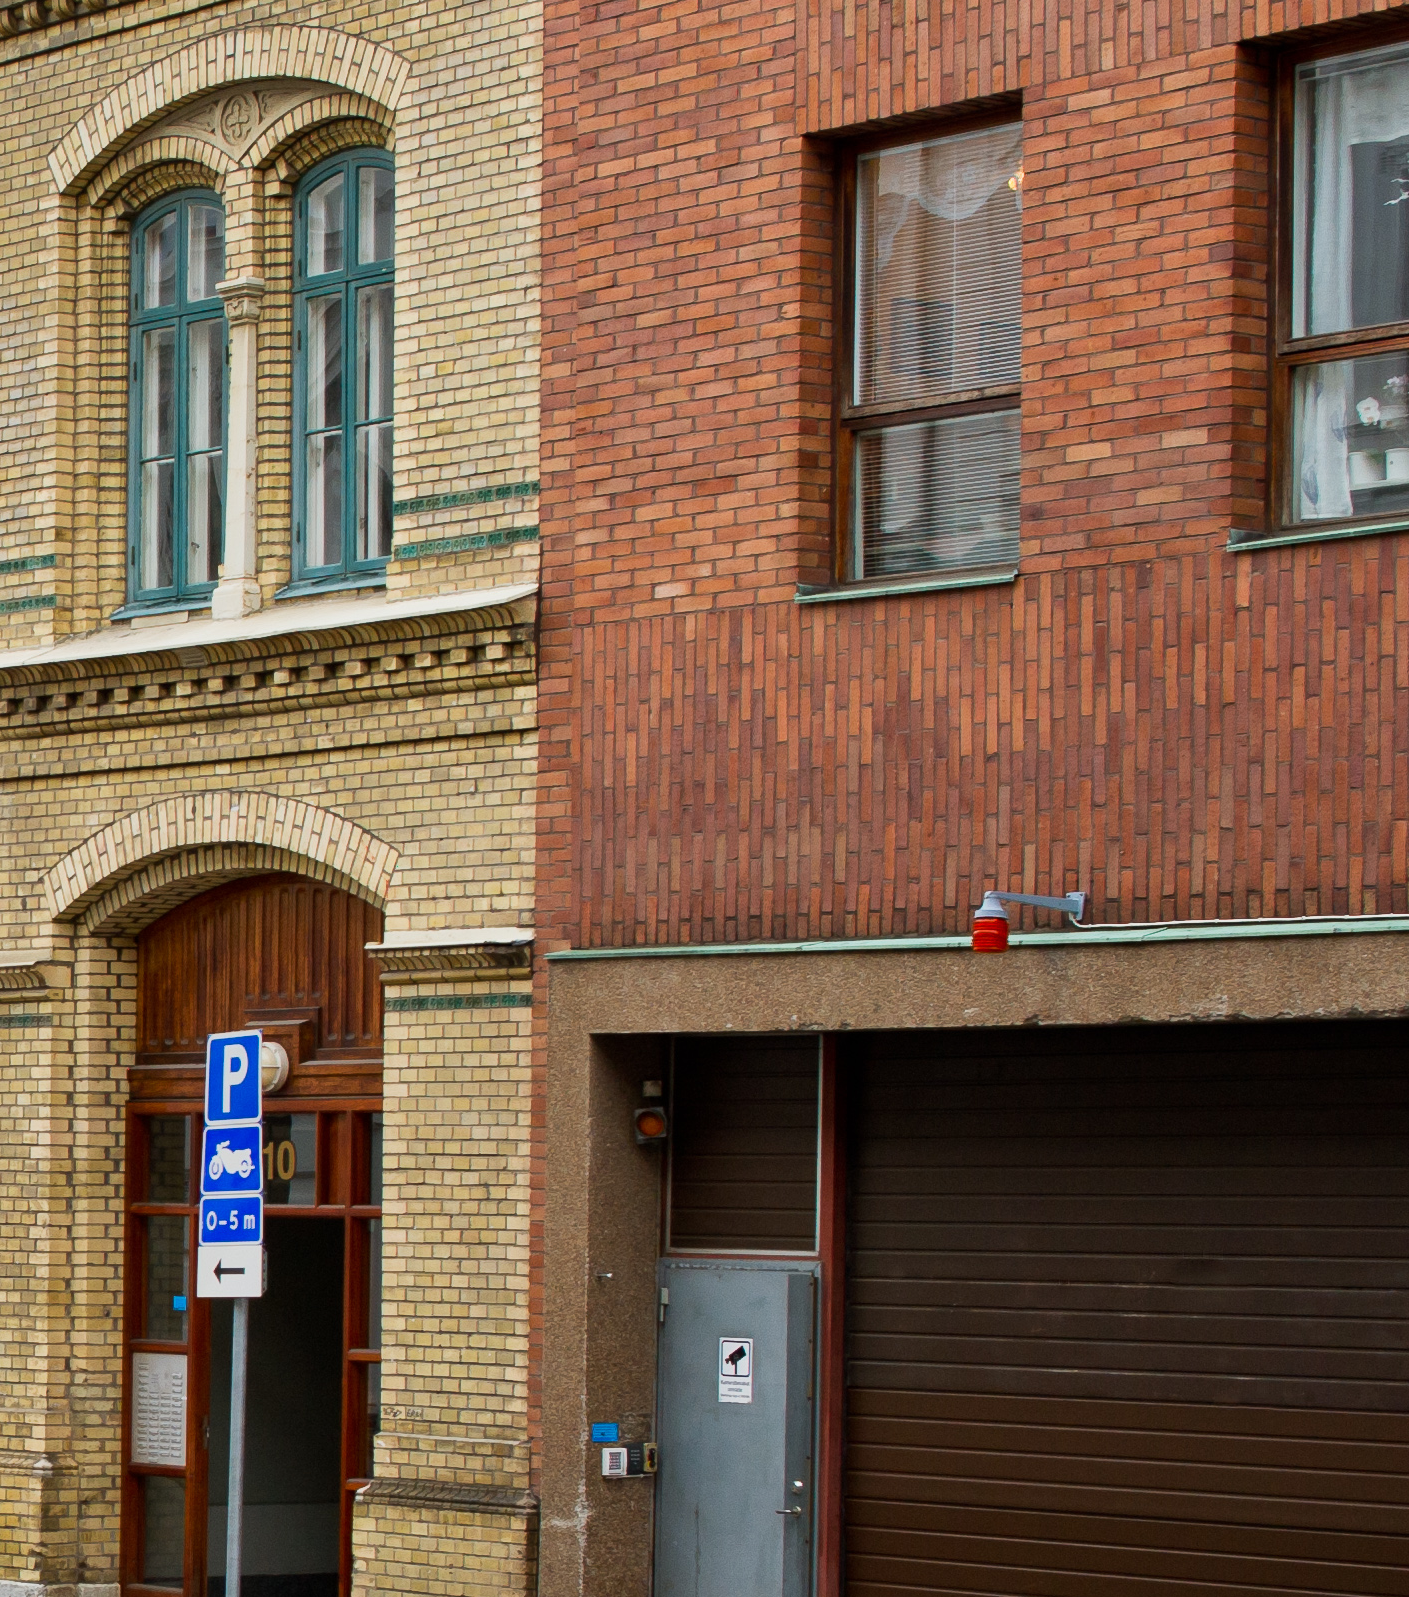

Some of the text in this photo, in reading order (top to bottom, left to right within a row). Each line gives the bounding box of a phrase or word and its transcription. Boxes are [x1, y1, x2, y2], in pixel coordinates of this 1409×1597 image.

[222, 1043, 249, 1113] P
[263, 1140, 296, 1180] 10
[206, 1210, 256, 1231] 0-5 m
